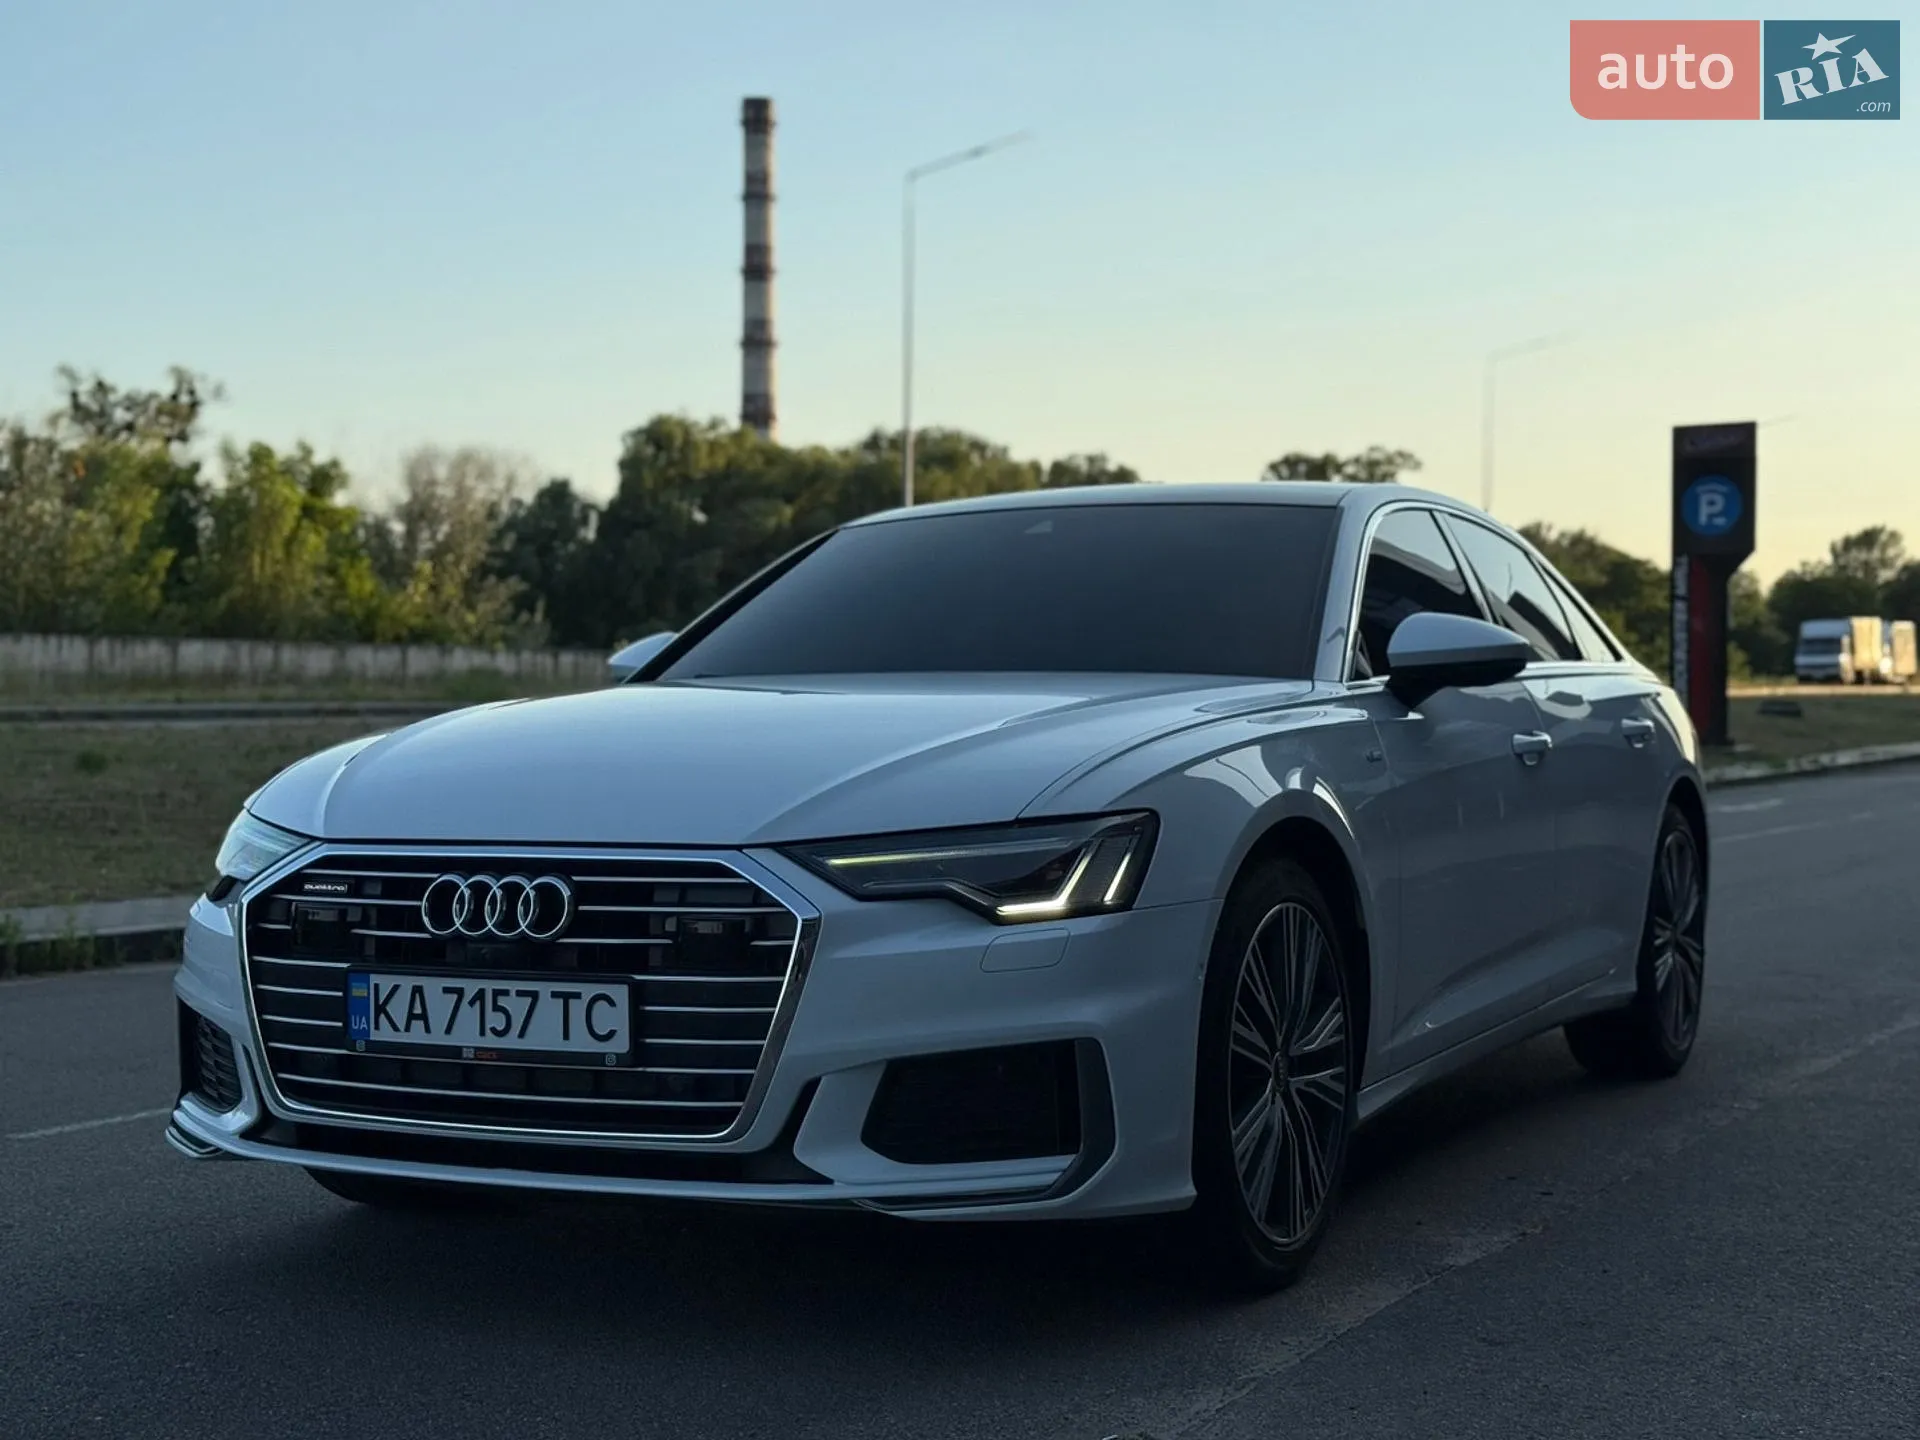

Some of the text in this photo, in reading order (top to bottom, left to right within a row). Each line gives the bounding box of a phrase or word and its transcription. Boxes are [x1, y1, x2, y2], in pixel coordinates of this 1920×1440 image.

[351, 1015, 368, 1030] UA
[373, 983, 618, 1042] KA 7157 TC
